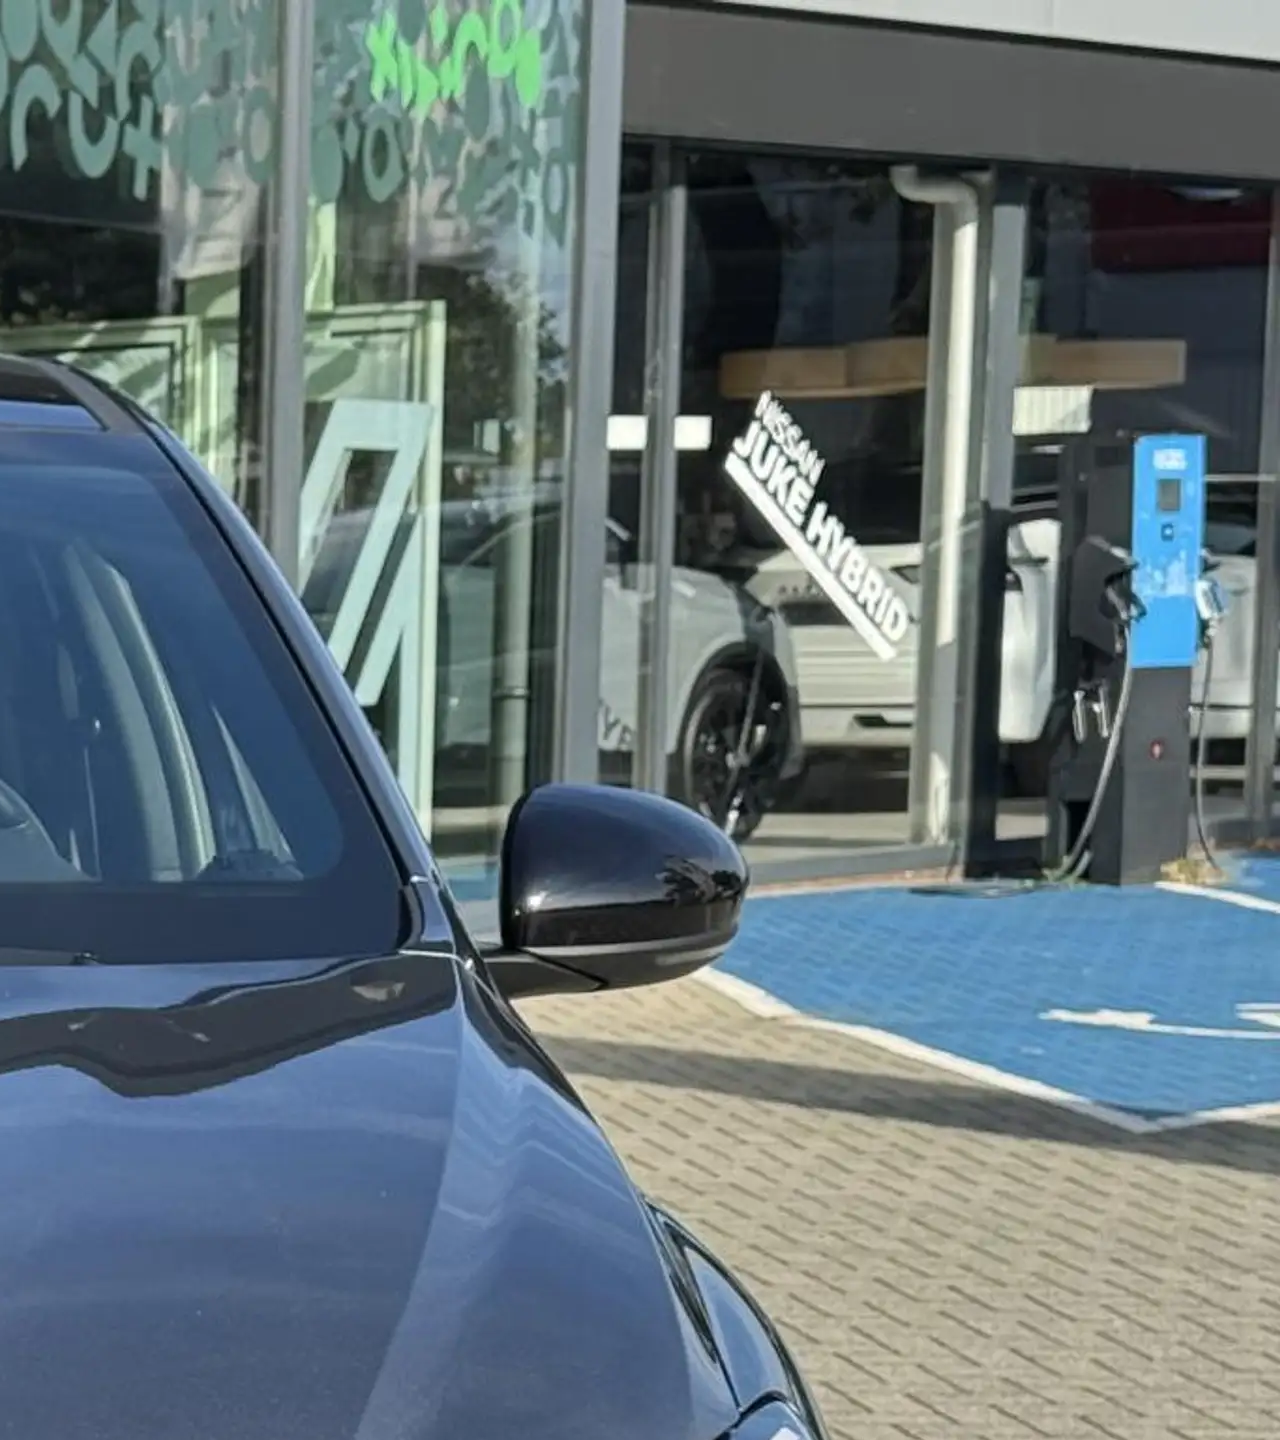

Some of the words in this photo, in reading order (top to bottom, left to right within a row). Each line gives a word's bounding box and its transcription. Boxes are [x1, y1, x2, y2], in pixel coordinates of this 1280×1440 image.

[755, 389, 826, 487] NISSAN
[732, 420, 816, 527] JUKE
[805, 501, 910, 642] HYBRID
